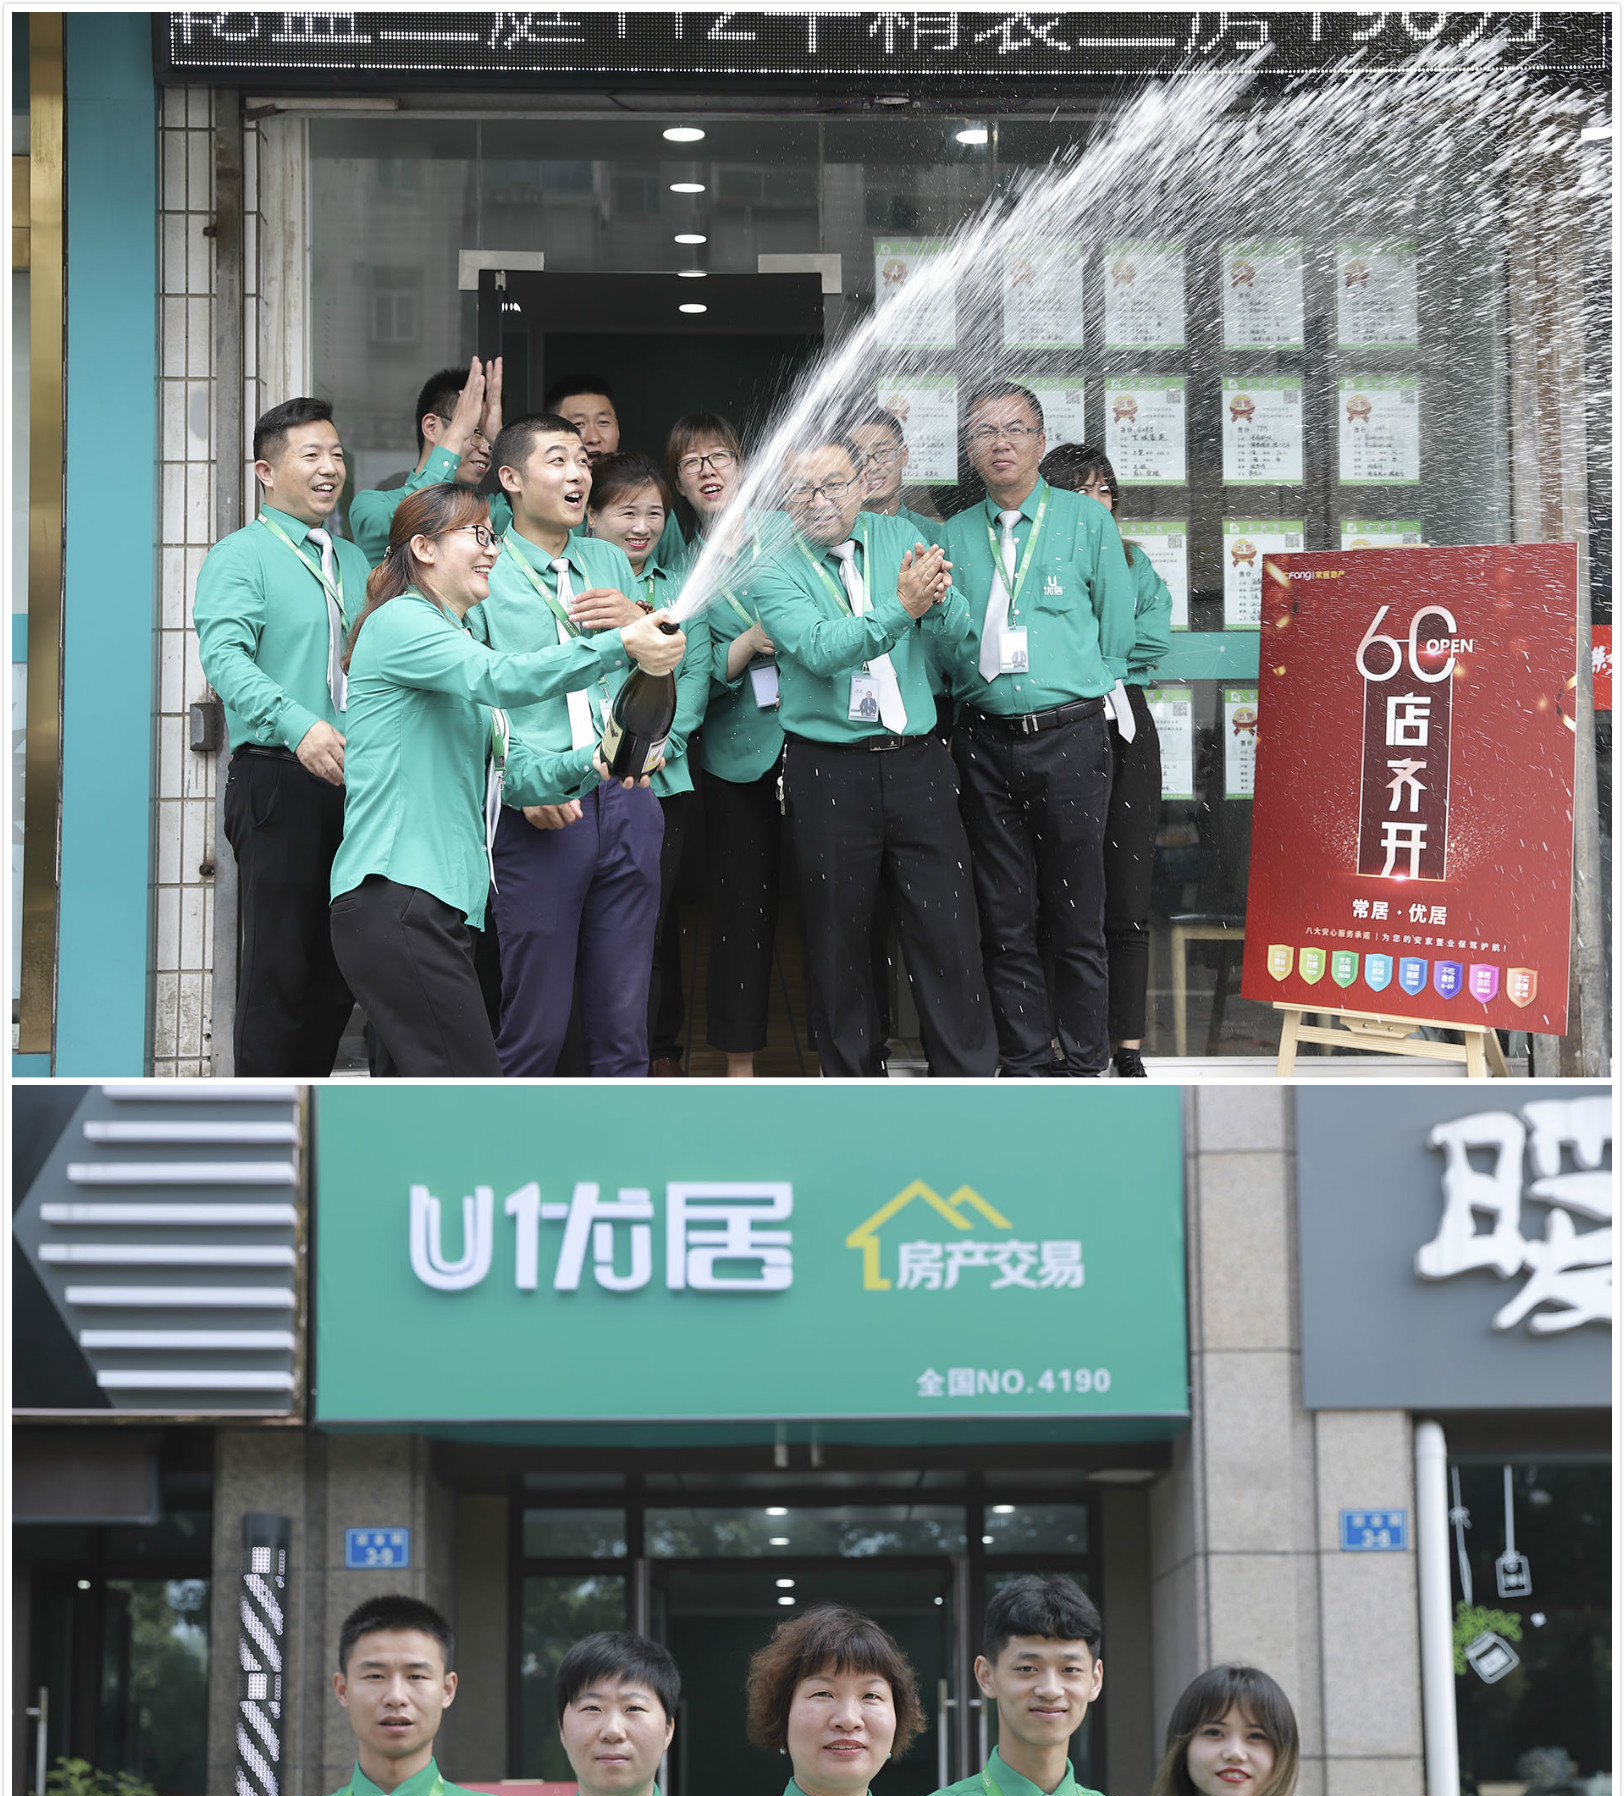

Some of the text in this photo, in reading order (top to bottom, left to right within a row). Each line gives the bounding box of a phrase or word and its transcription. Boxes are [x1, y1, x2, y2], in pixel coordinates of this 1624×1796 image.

[1426, 637, 1475, 655] OPEN
[896, 1240, 1085, 1291] 房产交易
[915, 1366, 1112, 1397] 全国NO.4190
